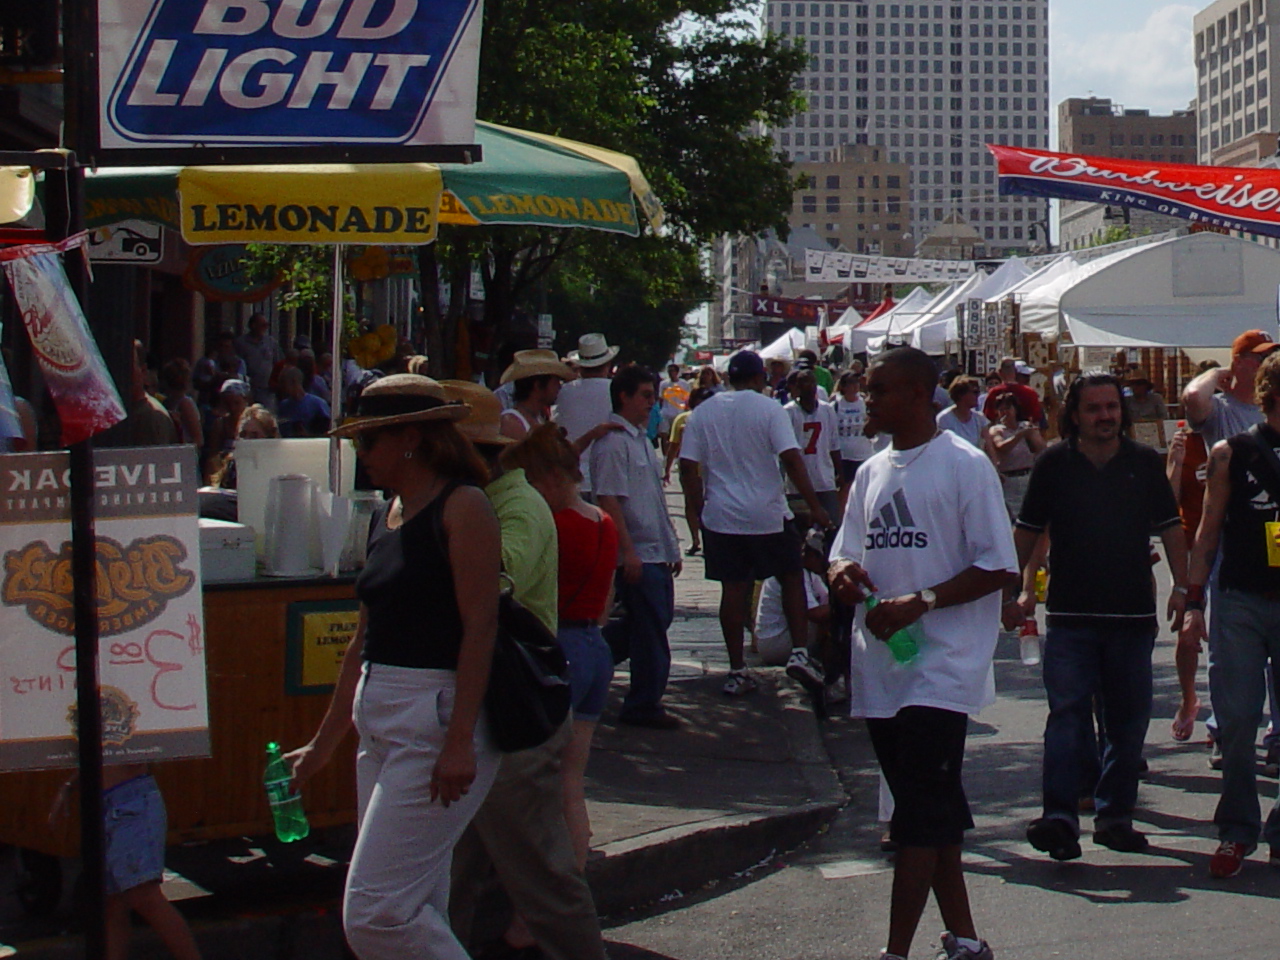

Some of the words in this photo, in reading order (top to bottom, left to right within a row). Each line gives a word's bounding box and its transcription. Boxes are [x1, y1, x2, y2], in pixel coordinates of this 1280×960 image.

[126, 39, 431, 110] LIGHT
[191, 203, 431, 233] LEMONADE
[468, 194, 636, 226] LEMONADE
[1100, 190, 1148, 207] KING
[1158, 202, 1181, 216] OF
[803, 422, 822, 455] 7
[865, 526, 929, 551] adidas
